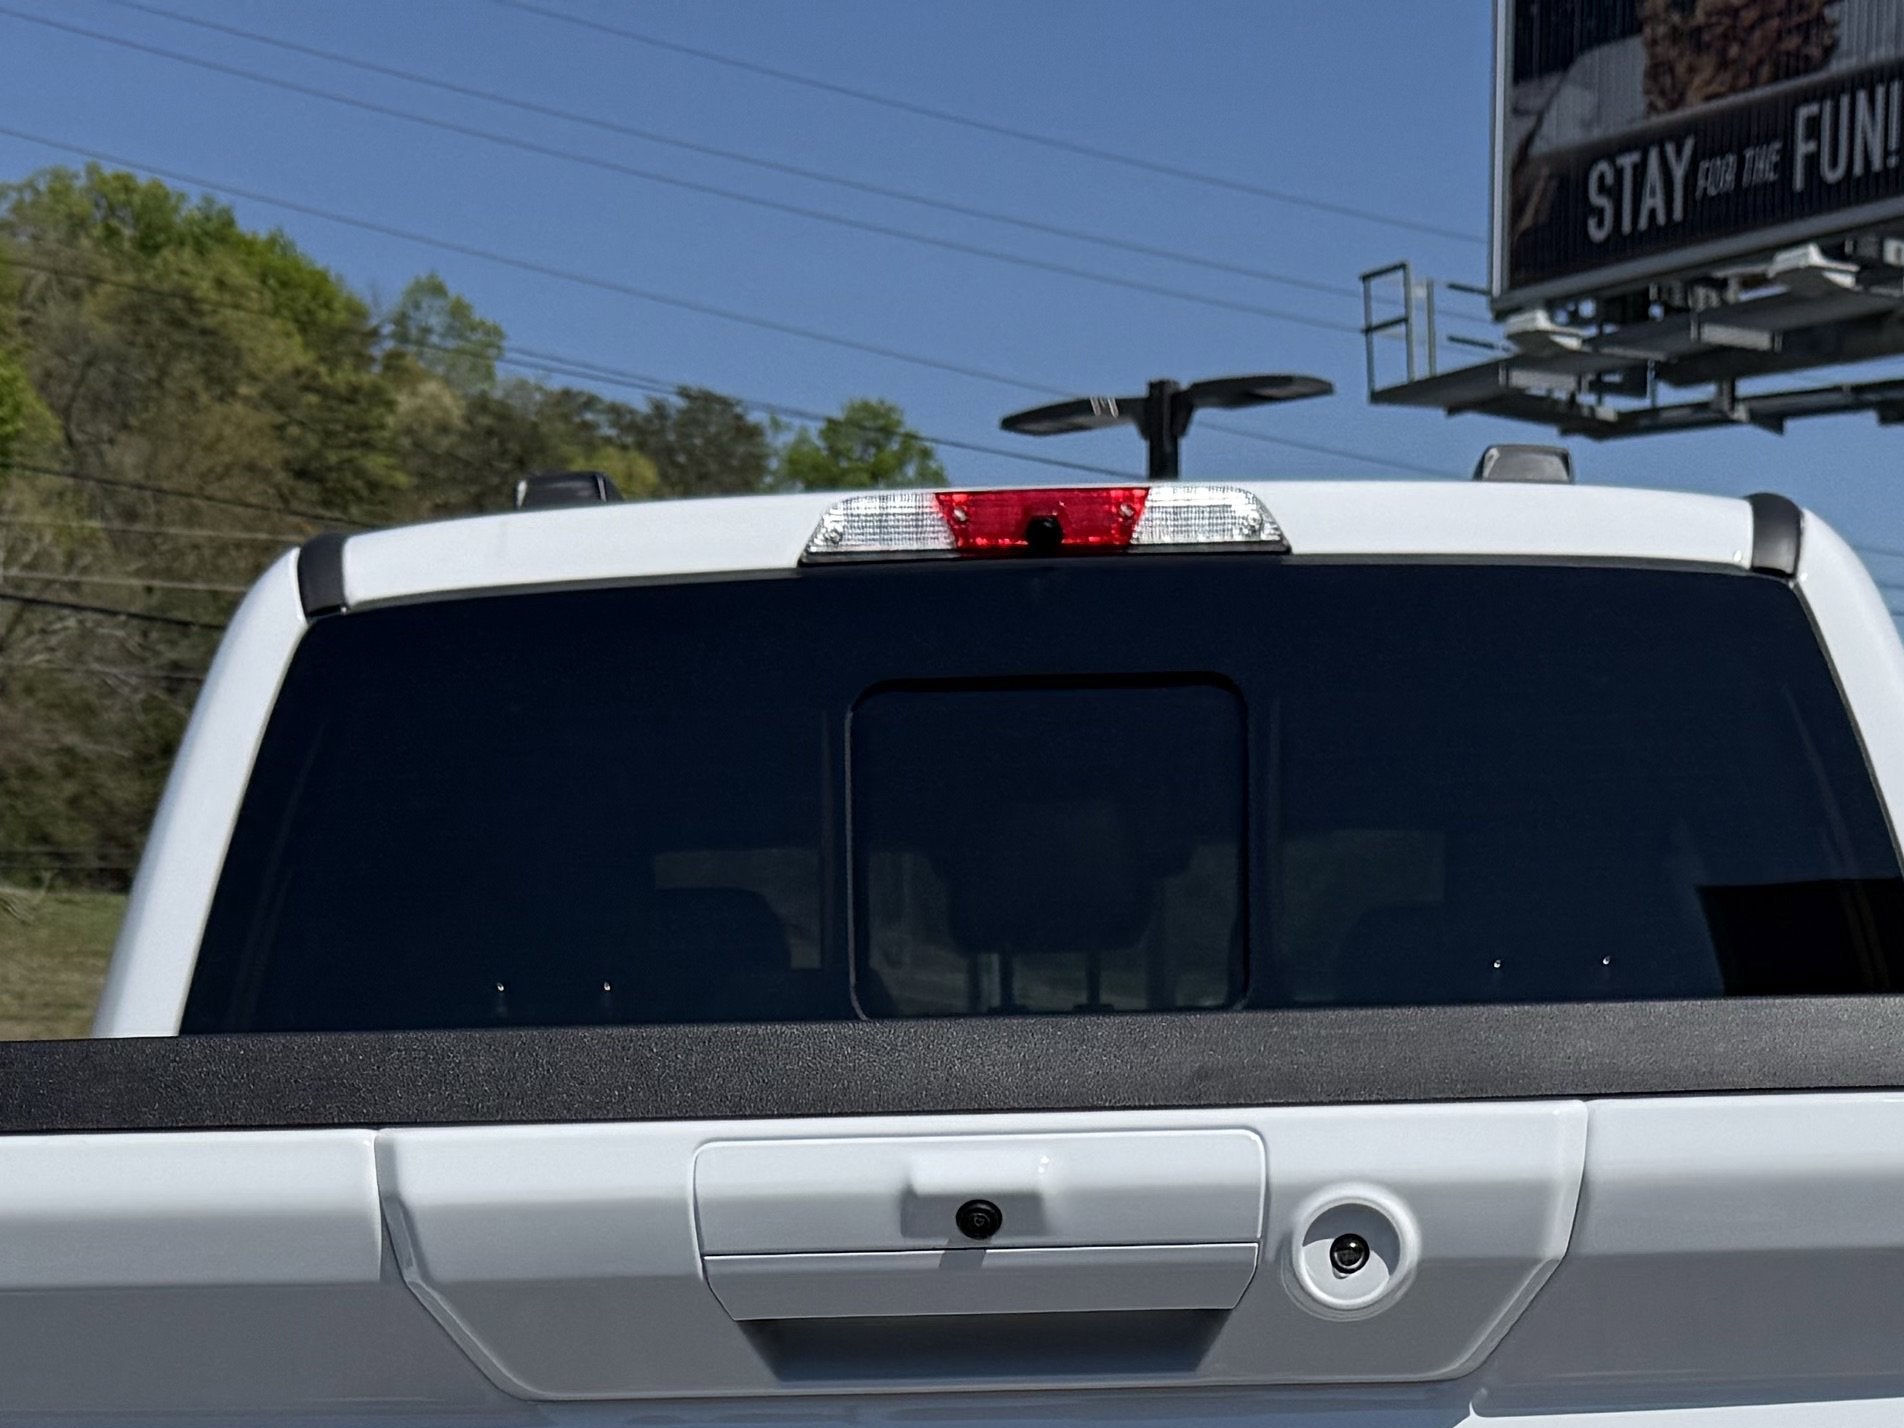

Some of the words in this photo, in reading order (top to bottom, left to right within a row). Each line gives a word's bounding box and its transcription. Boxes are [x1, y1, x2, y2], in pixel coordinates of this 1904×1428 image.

[1587, 133, 1696, 243] STAY
[1695, 152, 1737, 200] FOR
[1742, 140, 1783, 187] THE
[1792, 78, 1902, 193] FUN!
